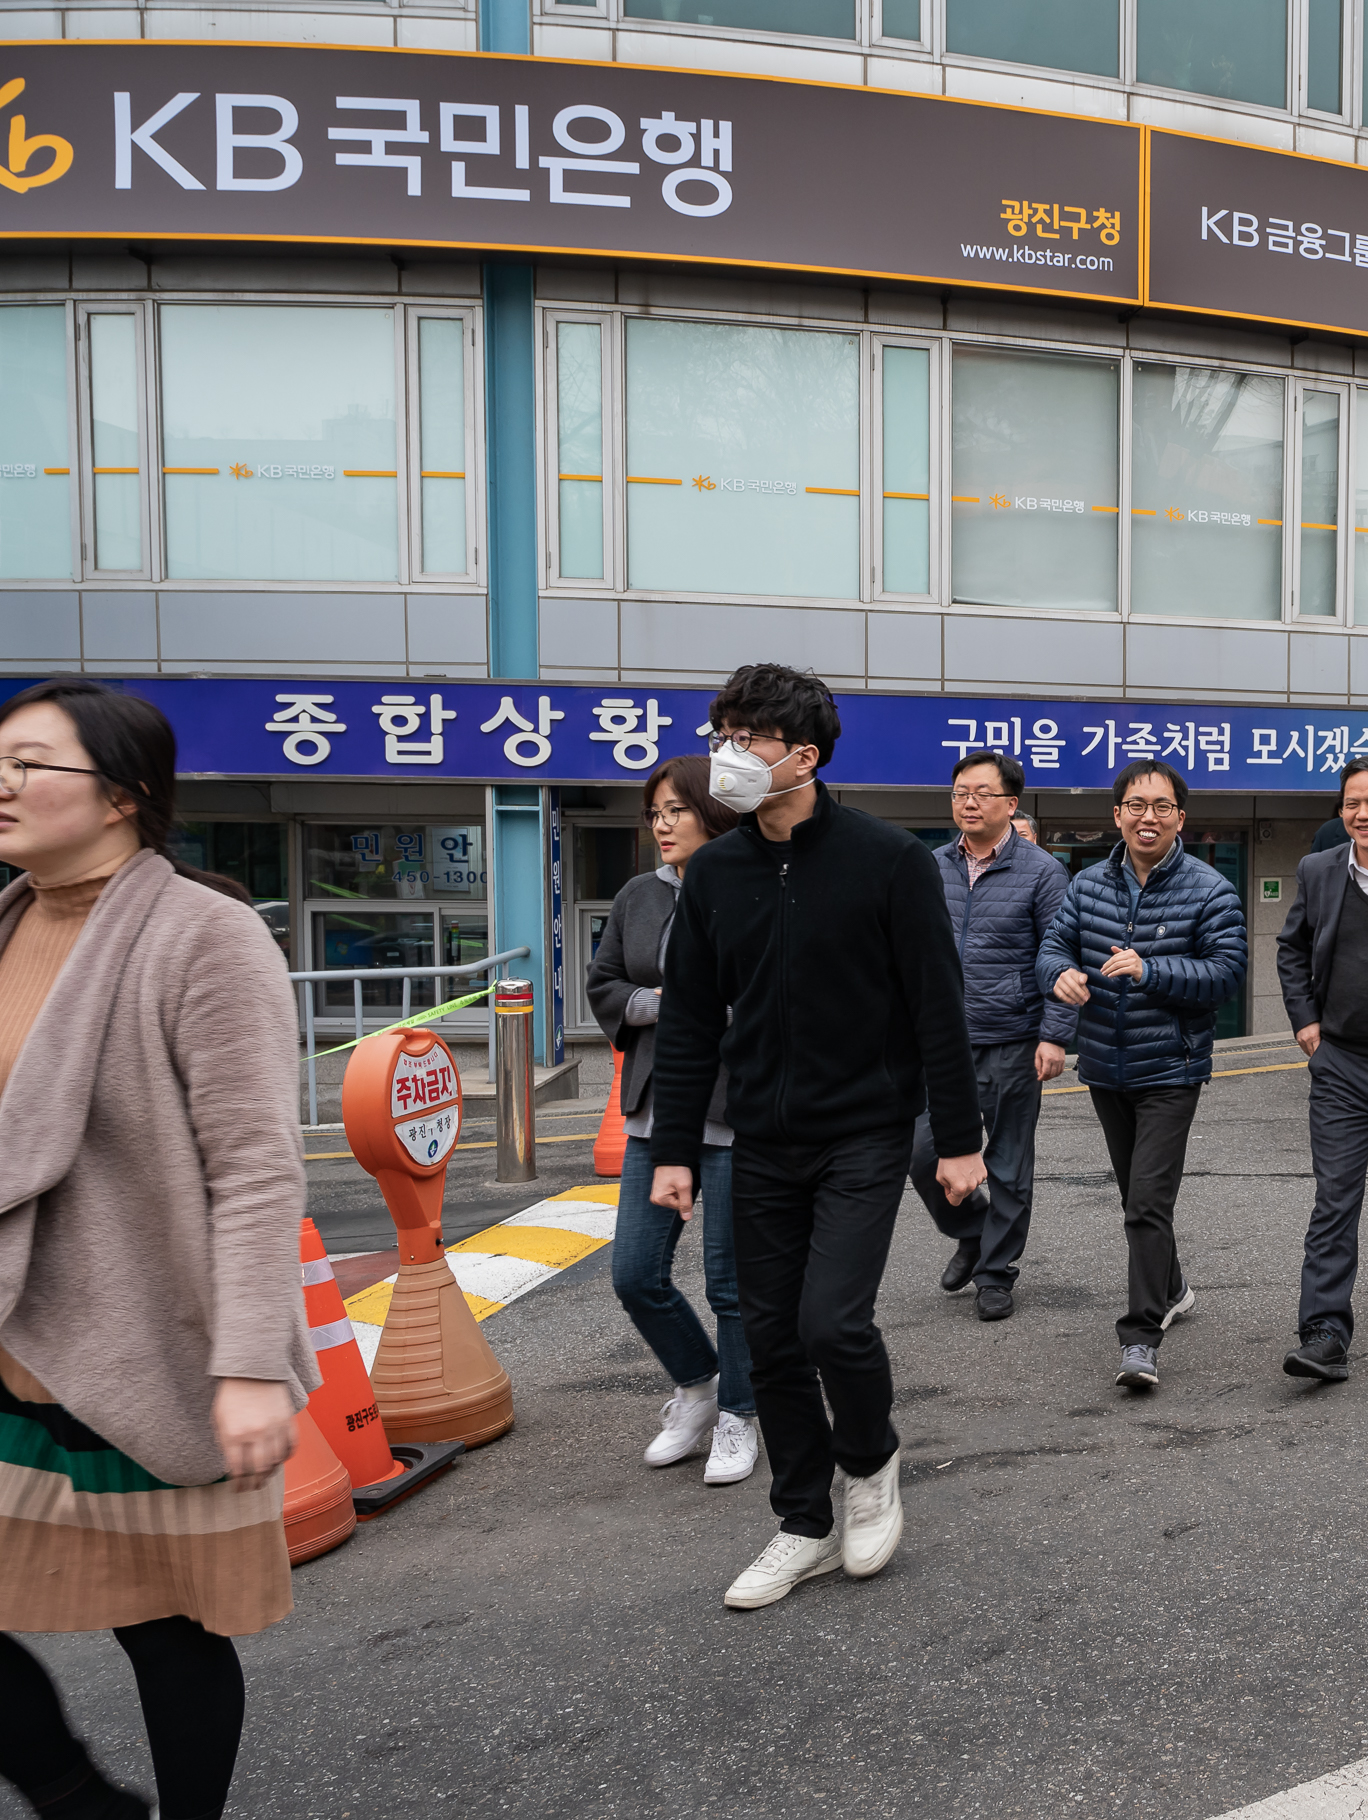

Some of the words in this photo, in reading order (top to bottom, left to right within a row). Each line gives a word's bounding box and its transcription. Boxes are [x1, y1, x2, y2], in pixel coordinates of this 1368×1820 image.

[113, 90, 733, 218] KB국민은행
[1000, 199, 1120, 246] 광진구청
[960, 243, 1113, 272] www.kbstar.com
[0, 464, 36, 478] 민은행
[265, 694, 713, 769] 종합상황
[941, 718, 1066, 769] 구민을
[1082, 719, 1232, 771] 가족처럼
[427, 1007, 445, 1018] SAFETY
[396, 1065, 452, 1111] 주차금지
